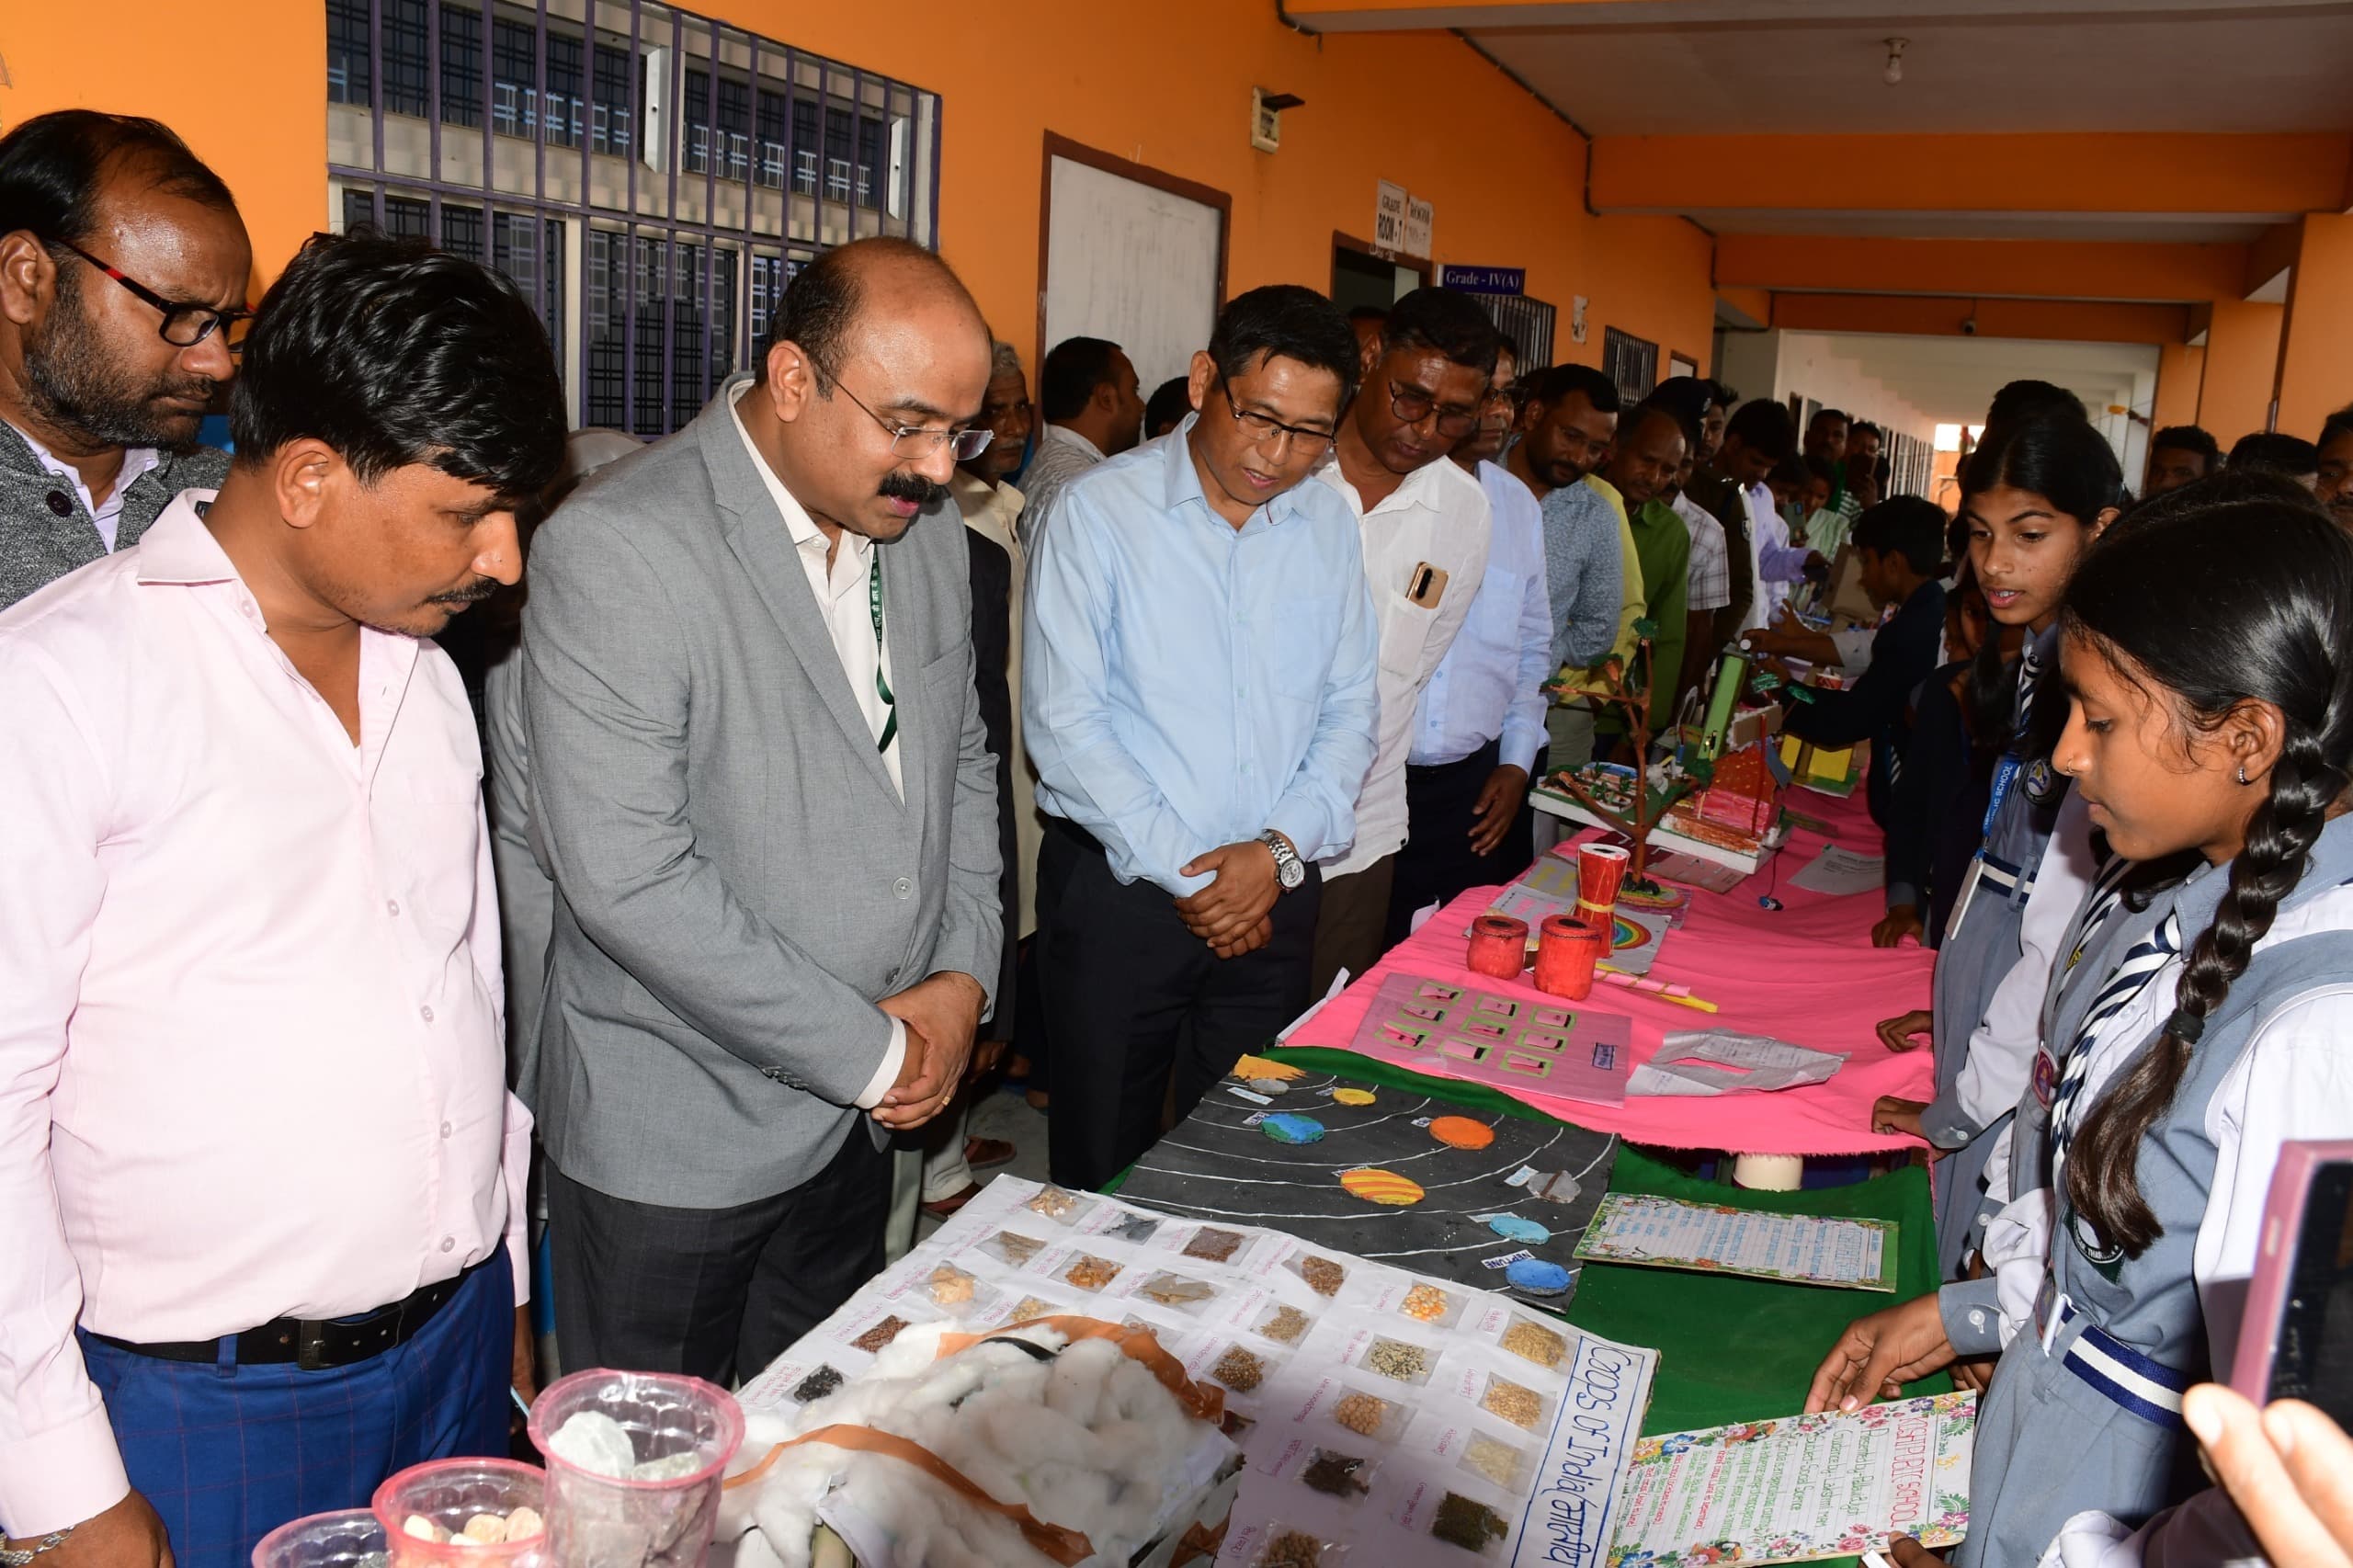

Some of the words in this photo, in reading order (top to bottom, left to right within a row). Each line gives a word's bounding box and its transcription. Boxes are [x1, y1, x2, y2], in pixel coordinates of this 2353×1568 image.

[1378, 212, 1394, 244] ROOM
[1446, 270, 1478, 285] Grade
[1489, 273, 1519, 290] IV(A)
[1995, 765, 2013, 796] SCHOOL
[1484, 1253, 1532, 1268] NEPTUNE
[1576, 1347, 1631, 1410] Crops
[1828, 1428, 1853, 1463] Guidance
[1855, 1426, 1890, 1462] Presented
[1890, 1445, 1926, 1483] PUBLIC
[1889, 1481, 1920, 1527] SCHOOL
